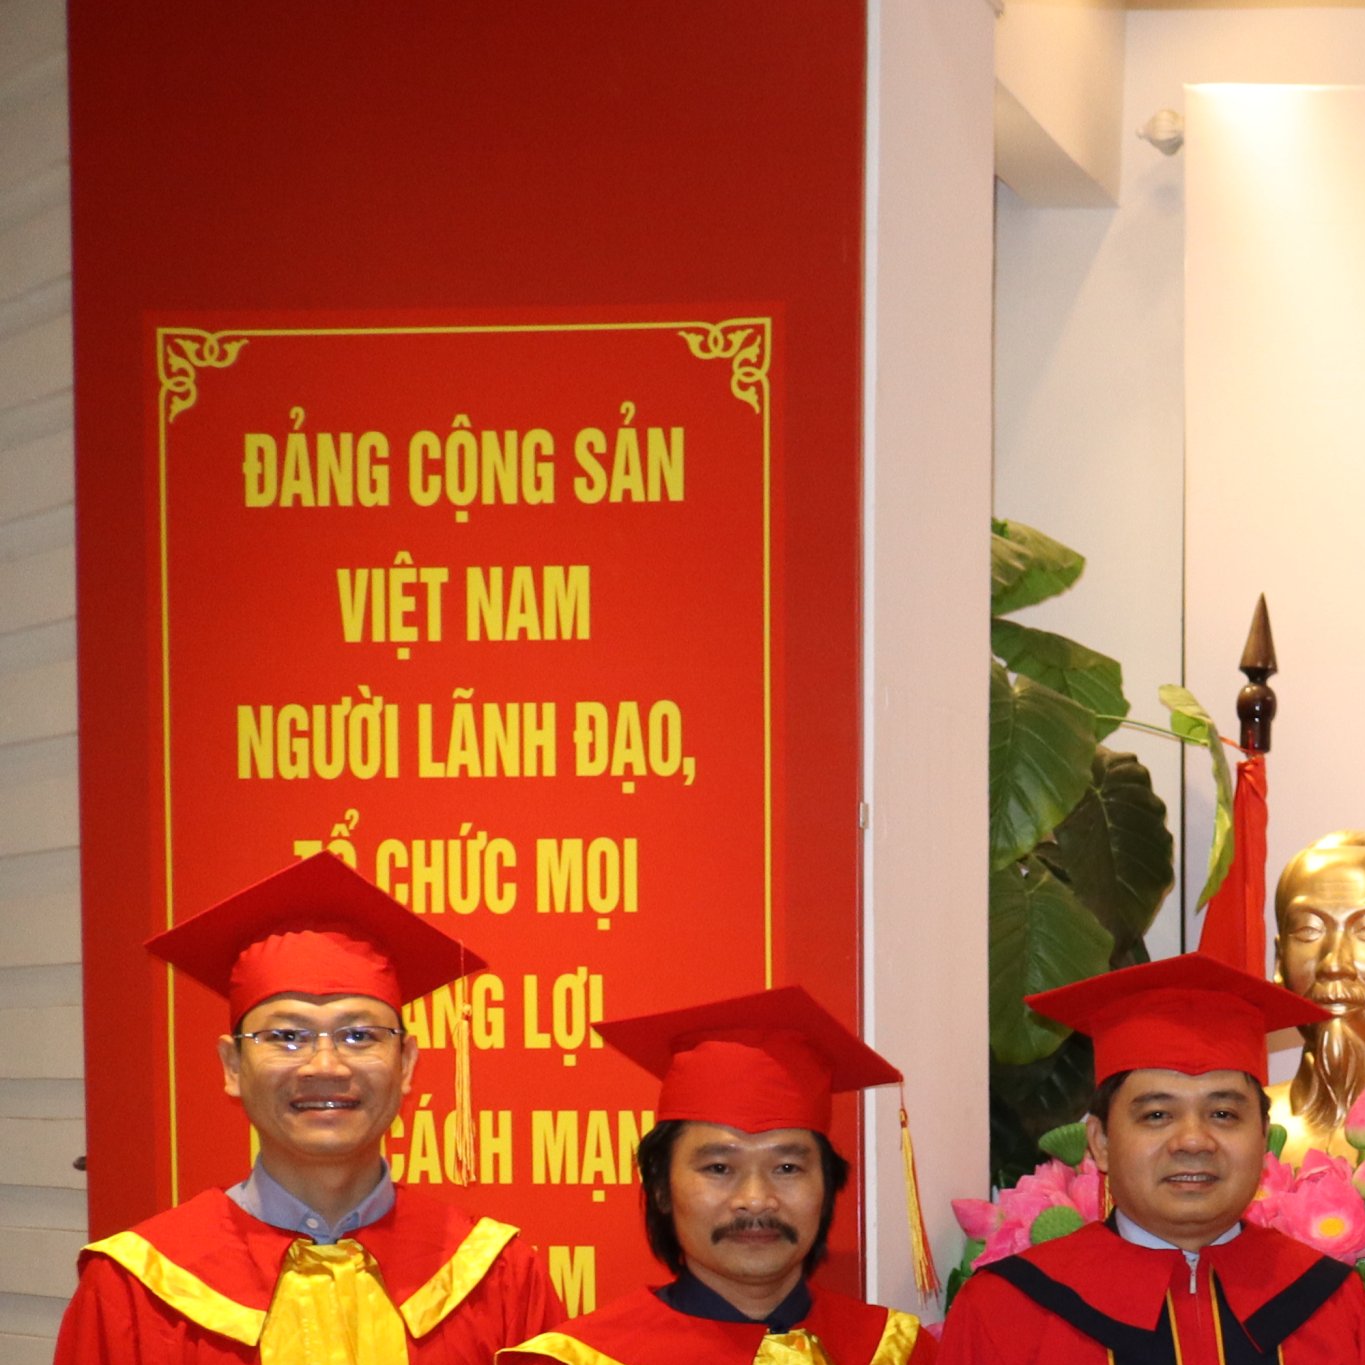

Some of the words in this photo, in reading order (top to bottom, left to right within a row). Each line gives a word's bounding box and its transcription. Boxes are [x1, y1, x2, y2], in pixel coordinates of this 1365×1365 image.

[244, 407, 389, 506] ĐẢNG
[410, 415, 554, 522] CỘNG
[575, 402, 683, 503] SẢN
[337, 552, 448, 659] VIỆT
[467, 566, 589, 641] NAM
[238, 685, 398, 779] NGƯỜI
[419, 688, 556, 777] LÃNH
[574, 700, 695, 793] ĐẠO,
[376, 823, 516, 914] CHỨC
[537, 837, 637, 930] MỌI
[524, 967, 603, 1066] LỢI
[532, 1110, 656, 1203] MẠN
